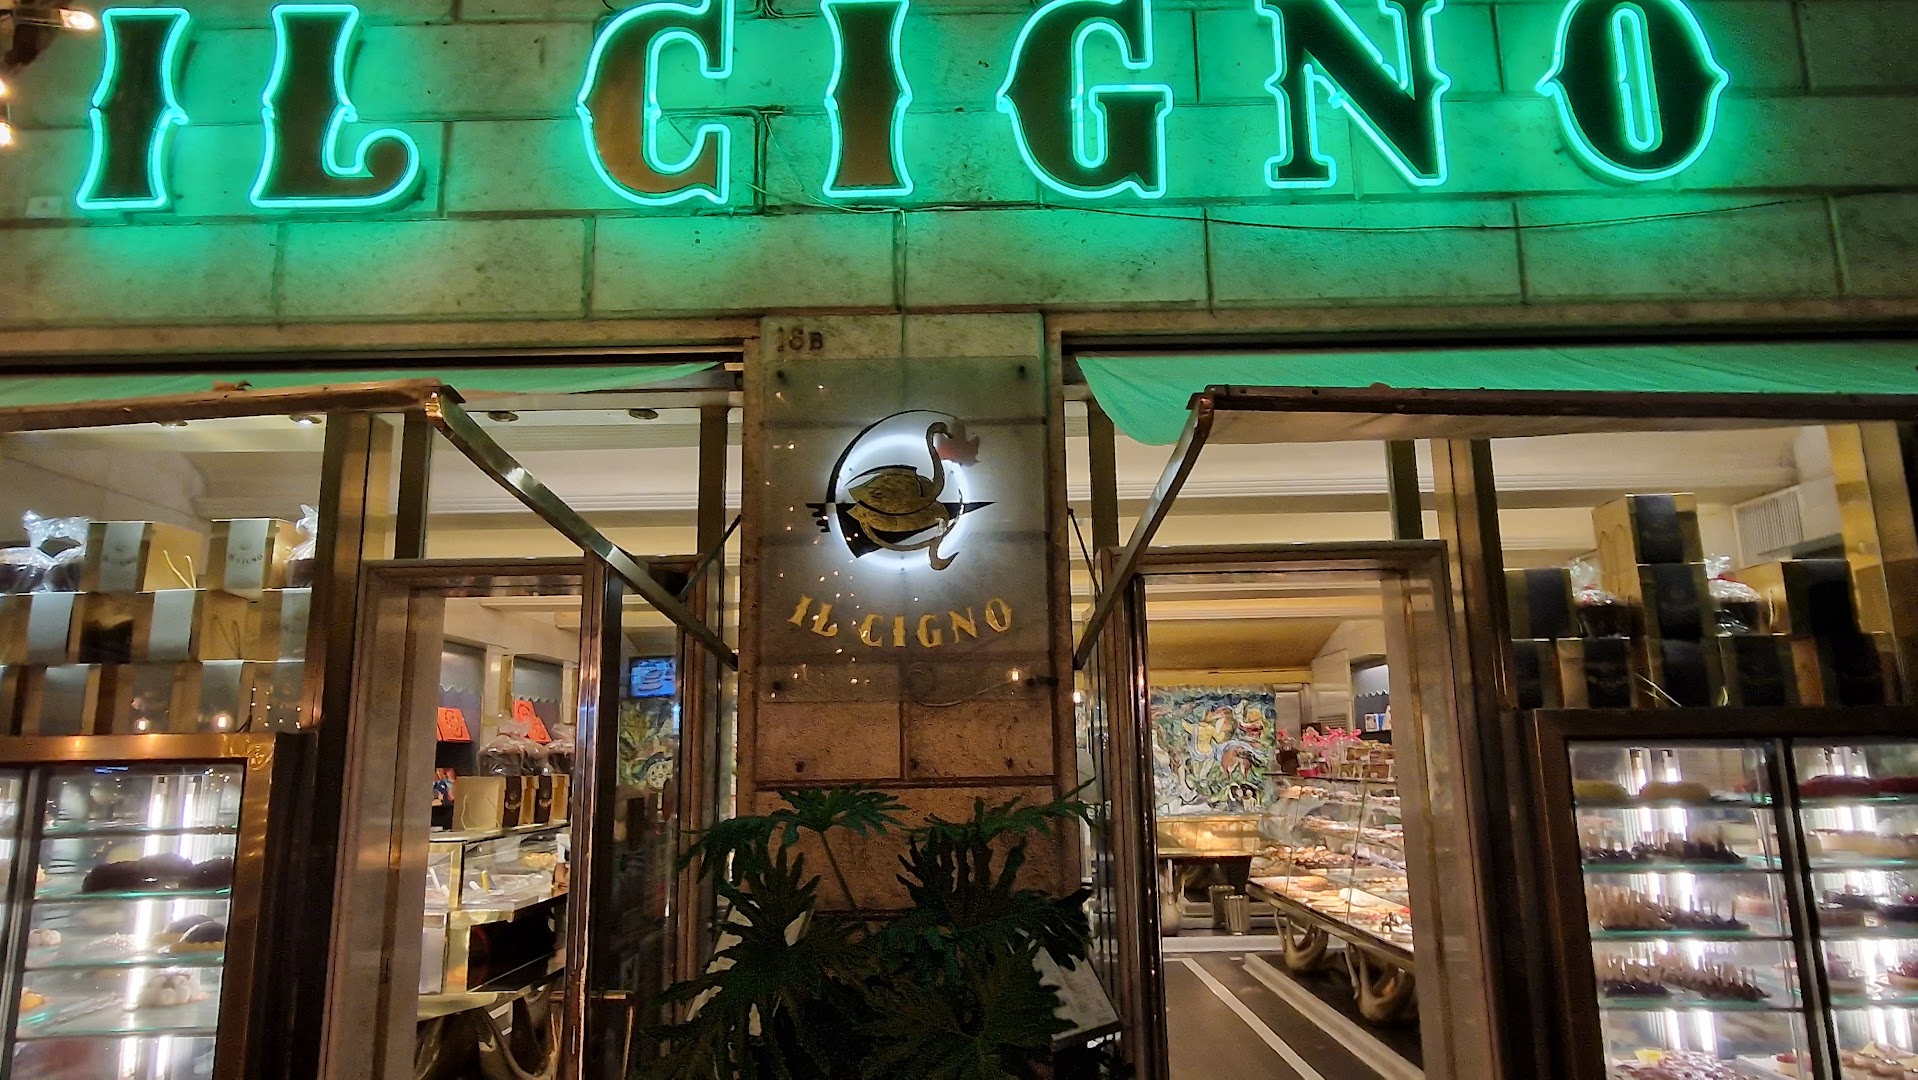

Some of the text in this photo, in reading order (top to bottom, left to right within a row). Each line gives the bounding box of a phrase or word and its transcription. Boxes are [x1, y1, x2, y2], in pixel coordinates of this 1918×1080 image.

[77, 0, 1730, 210] IL CIGNO
[787, 595, 1012, 648] IL CIGNO
